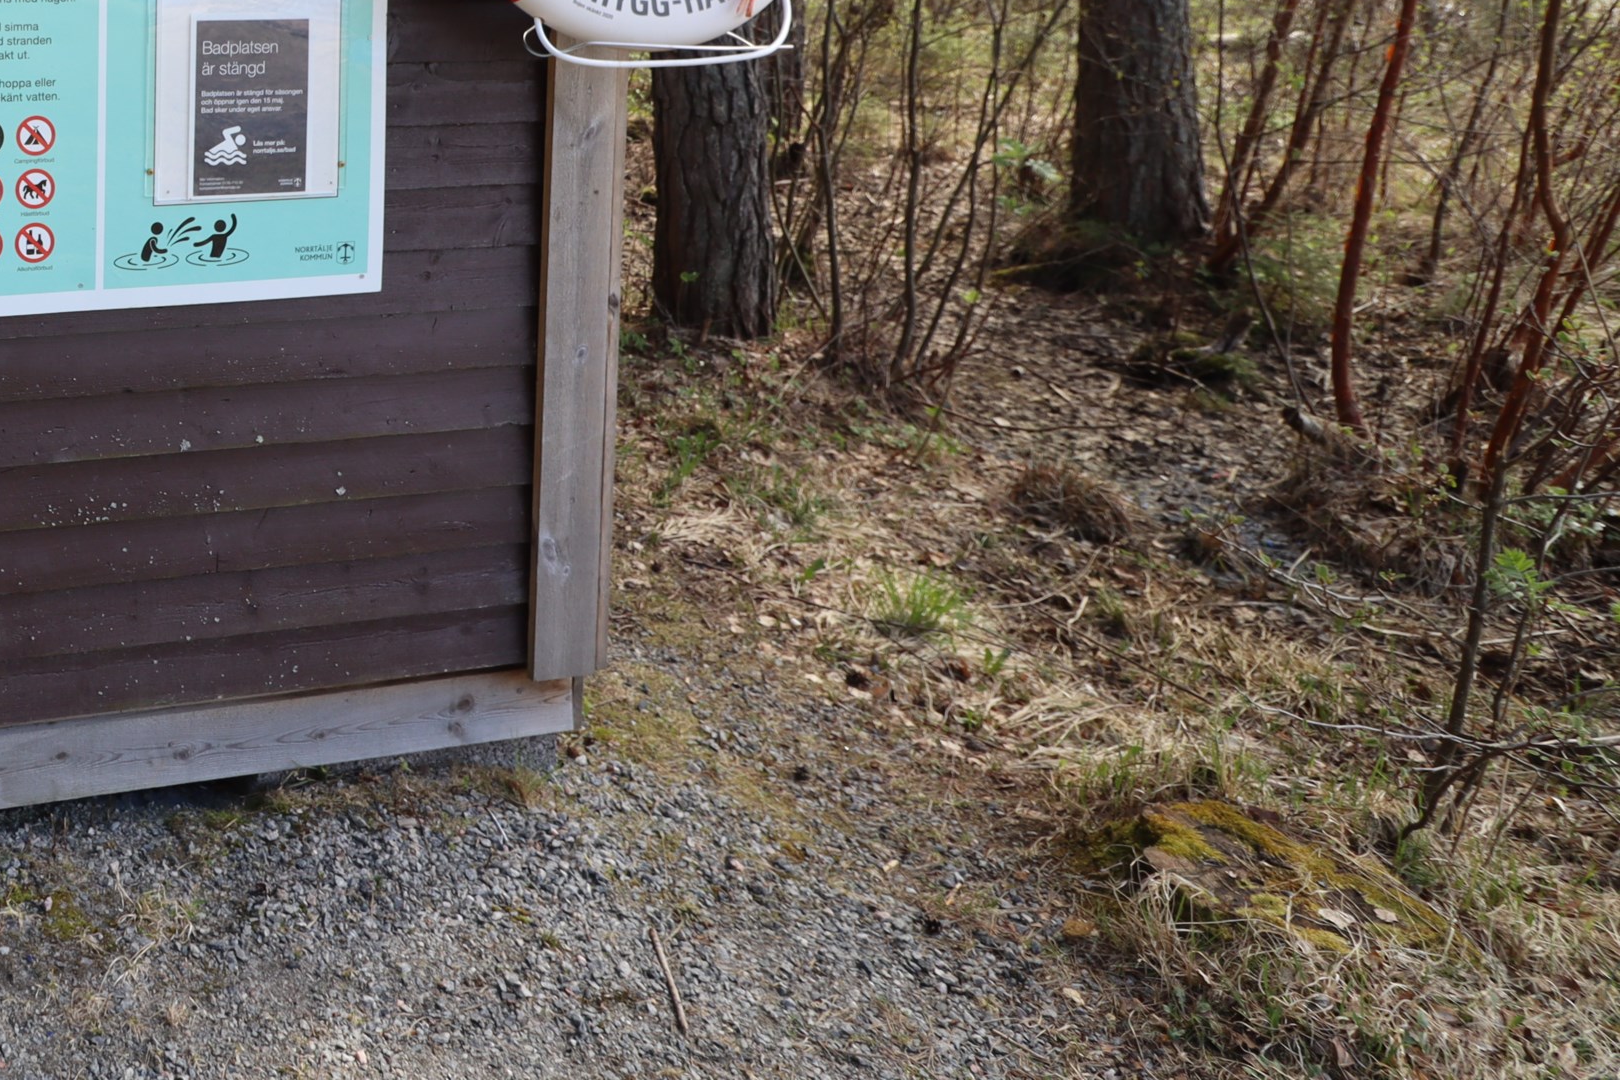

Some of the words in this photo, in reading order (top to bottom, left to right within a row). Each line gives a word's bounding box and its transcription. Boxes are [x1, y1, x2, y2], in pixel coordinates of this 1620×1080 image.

[5, 22, 39, 31] simma
[7, 36, 52, 45] stranden
[202, 41, 278, 57] Badplatsen
[17, 51, 29, 60] ut.
[202, 63, 215, 75] är
[219, 62, 265, 78] stängd
[0, 78, 32, 91] hoppa
[35, 78, 55, 87] eller
[26, 92, 60, 102] vatten.
[295, 245, 332, 253] NORRTÄLJE
[300, 253, 332, 261] KOMMUN
